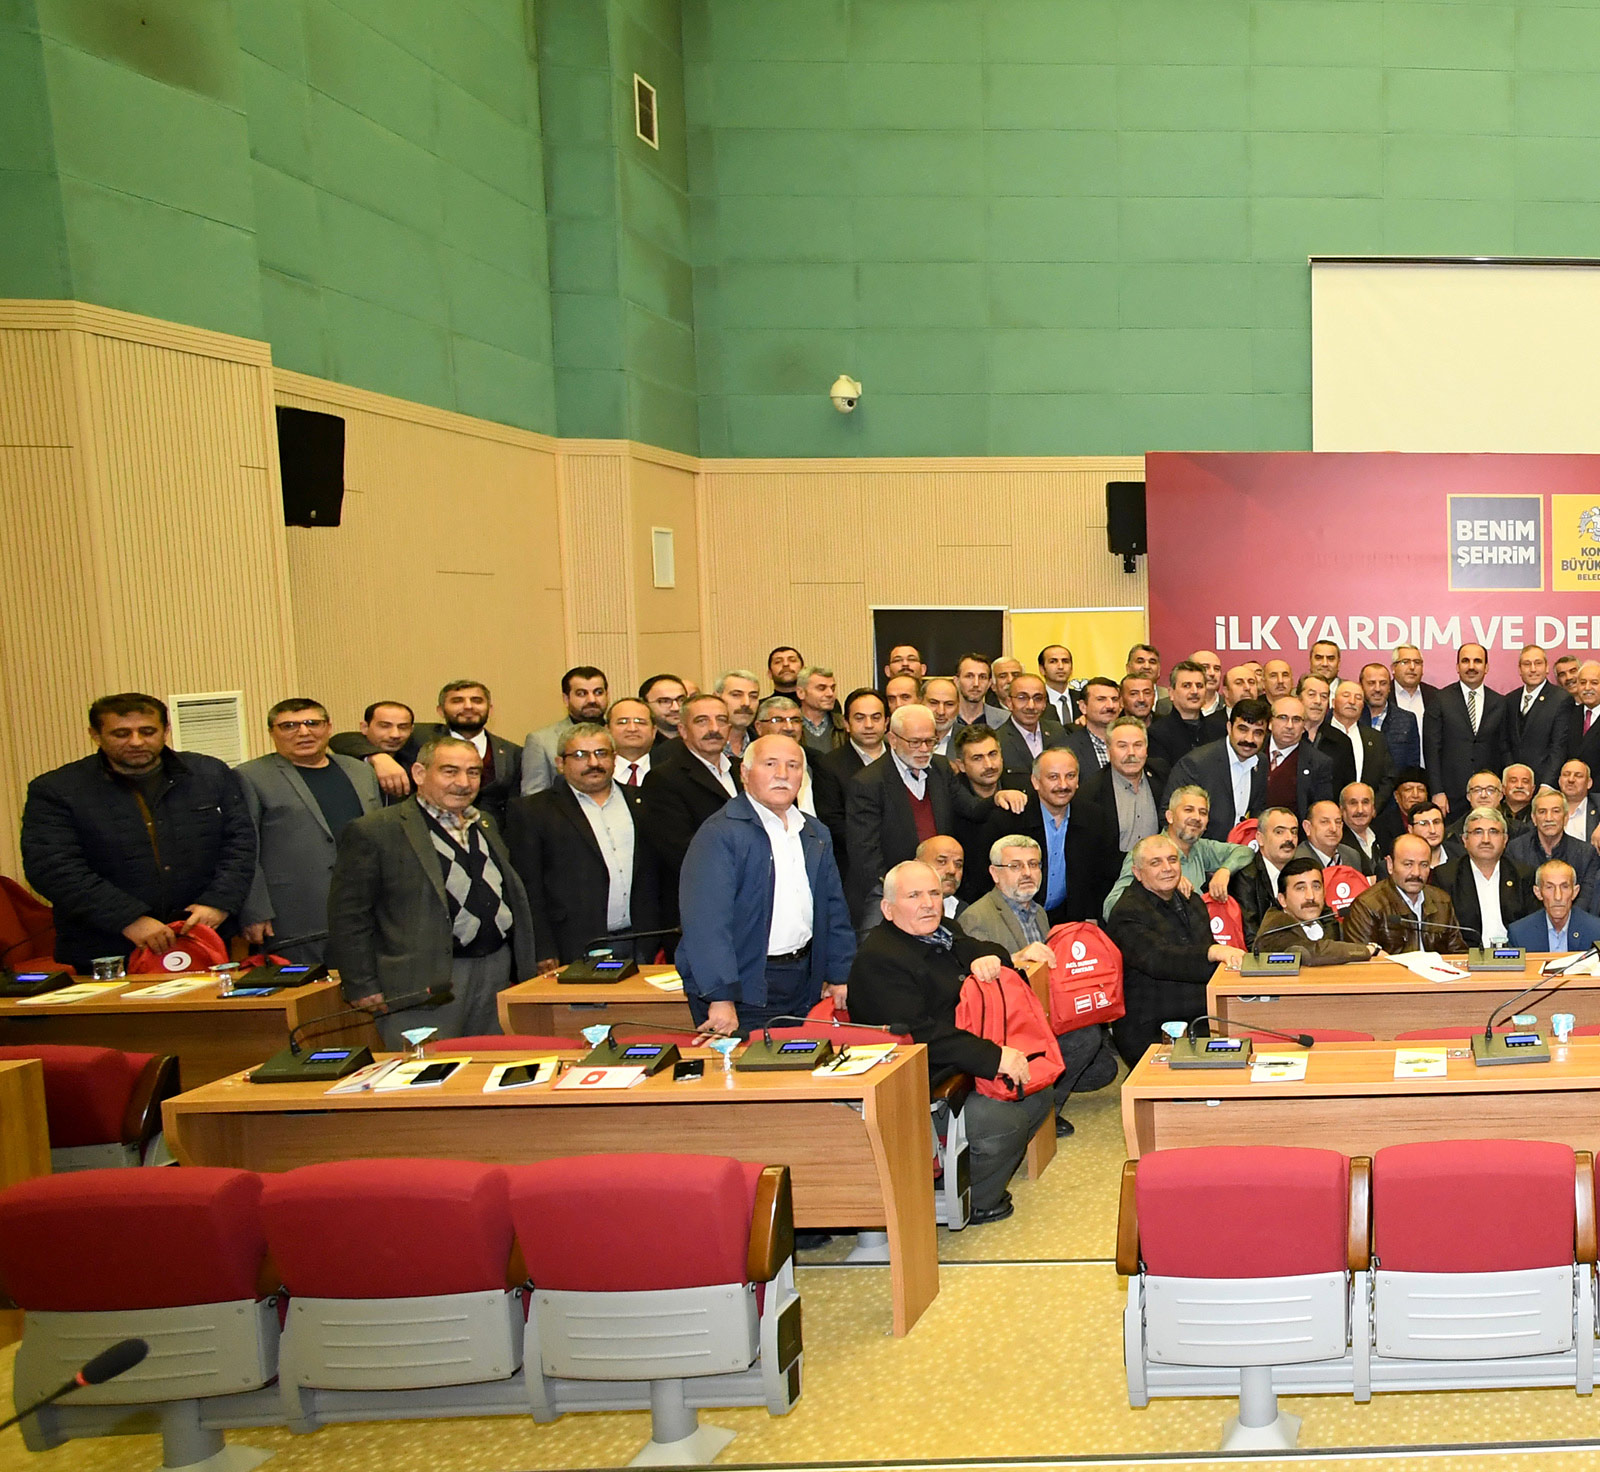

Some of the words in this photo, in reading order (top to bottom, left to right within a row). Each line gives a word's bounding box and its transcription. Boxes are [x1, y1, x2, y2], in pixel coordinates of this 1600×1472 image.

[1456, 520, 1535, 541] BENİM
[1457, 545, 1535, 567] ŞEHRİM
[1215, 615, 1281, 650] İLK
[1287, 615, 1460, 650] YARDIM
[1470, 615, 1524, 650] VE
